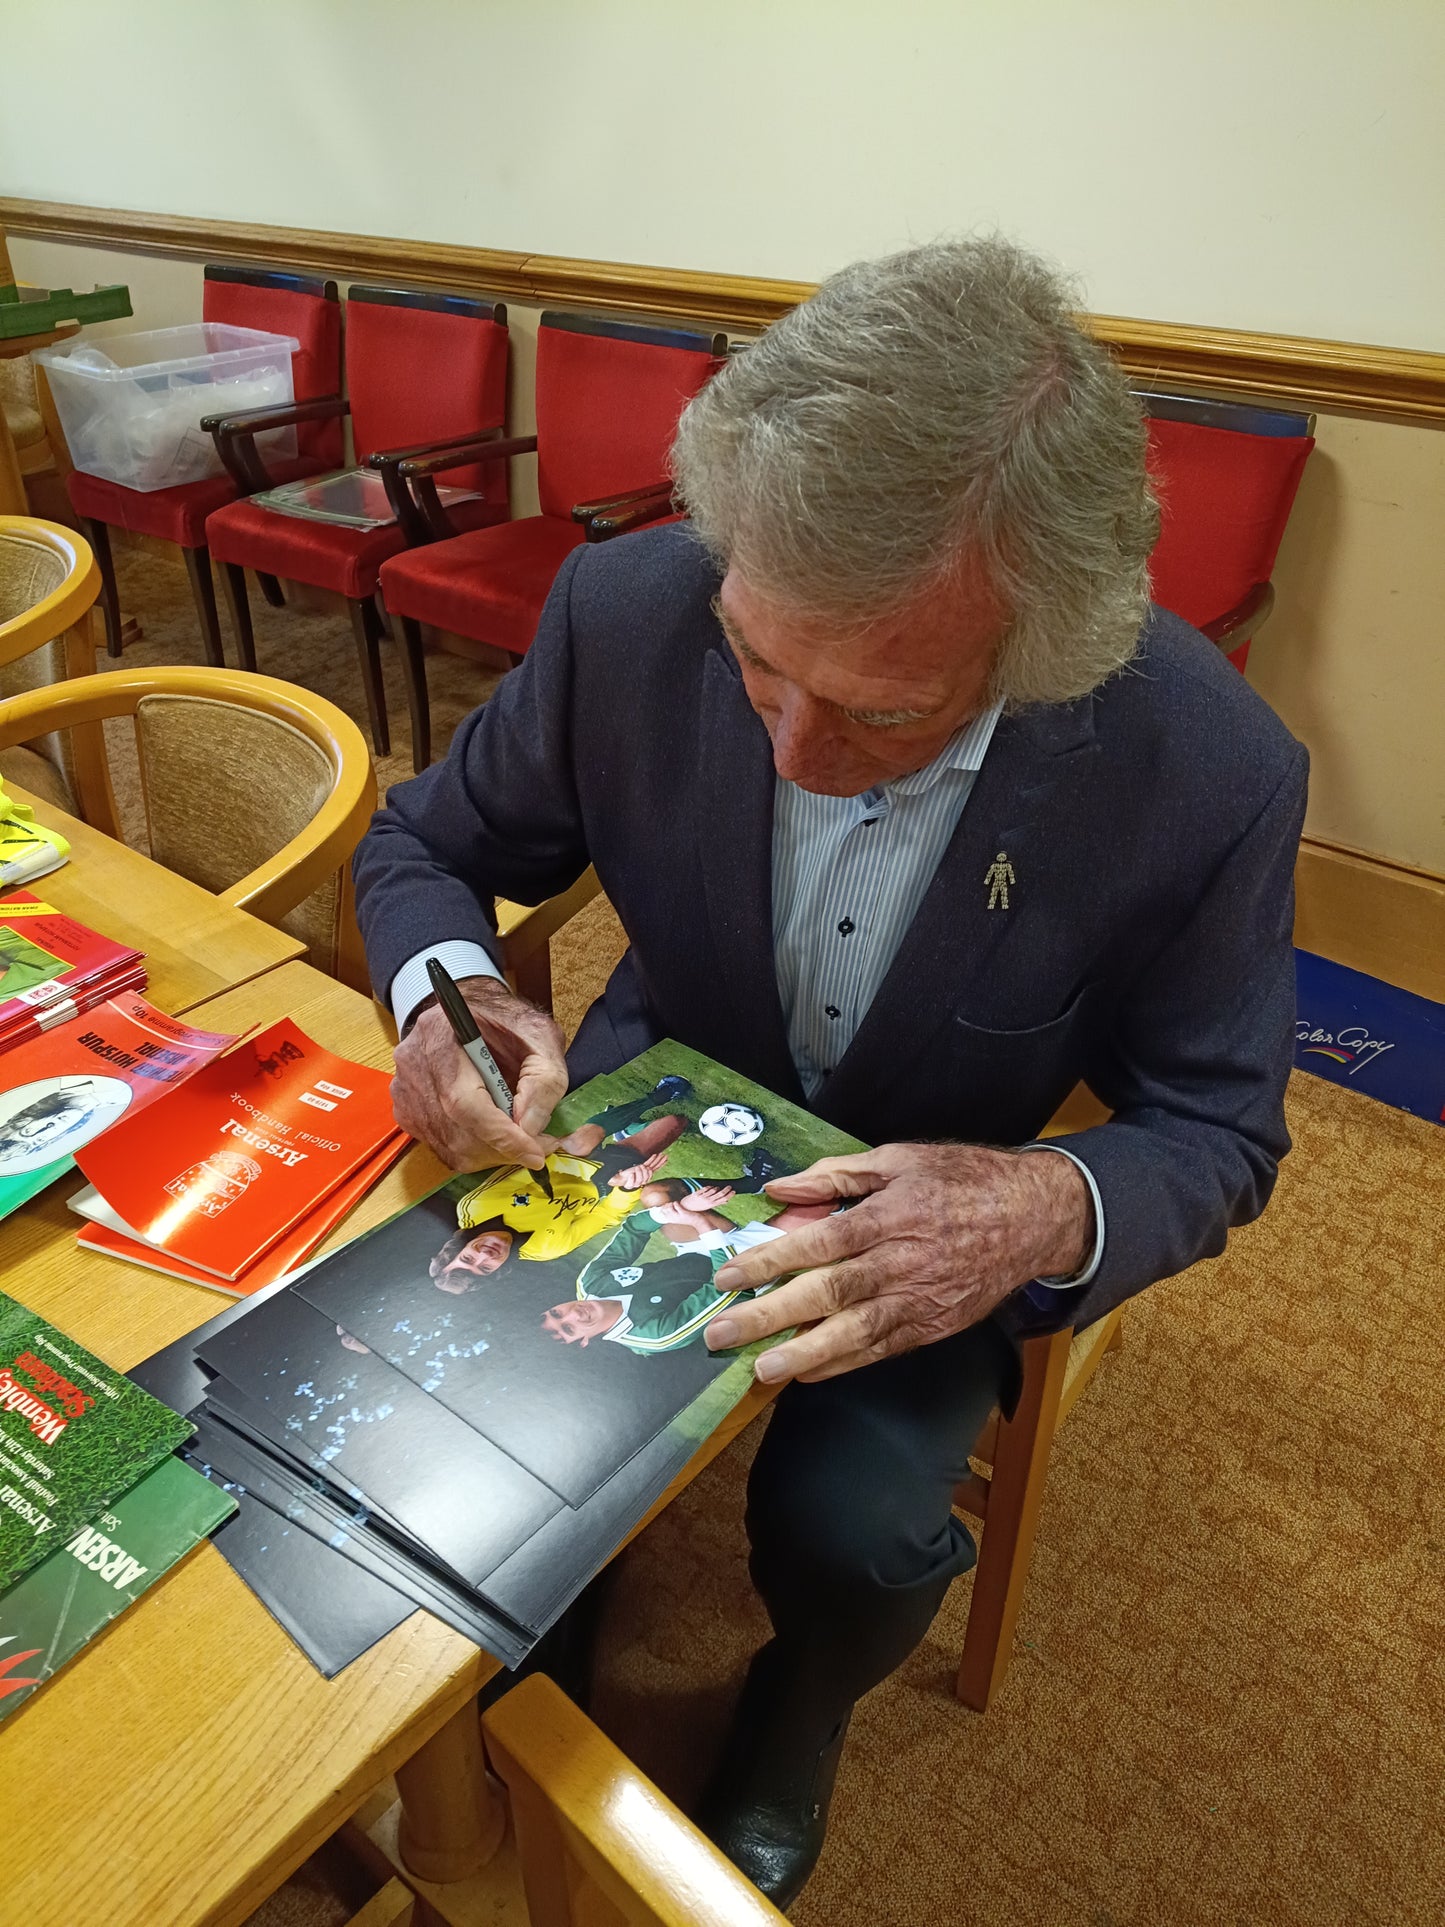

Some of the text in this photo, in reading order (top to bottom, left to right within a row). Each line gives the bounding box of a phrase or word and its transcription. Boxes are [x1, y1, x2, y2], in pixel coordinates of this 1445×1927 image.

[132, 1004, 149, 1020] 10p
[76, 1031, 138, 1069] HOTSPUR
[134, 1040, 188, 1066] ARSENAL
[1337, 1027, 1396, 1075] Copy
[229, 1091, 342, 1154] Official Handbook
[219, 1117, 309, 1170] Arsenal
[44, 1340, 77, 1369] Programme
[14, 1350, 97, 1418] Stadium
[72, 1363, 101, 1385] Souvenir
[94, 1380, 121, 1400] Official
[3, 1437, 24, 1455] 12th
[19, 1450, 56, 1480] Saturday
[24, 1477, 59, 1508] Football
[60, 1523, 149, 1590] ARSEN
